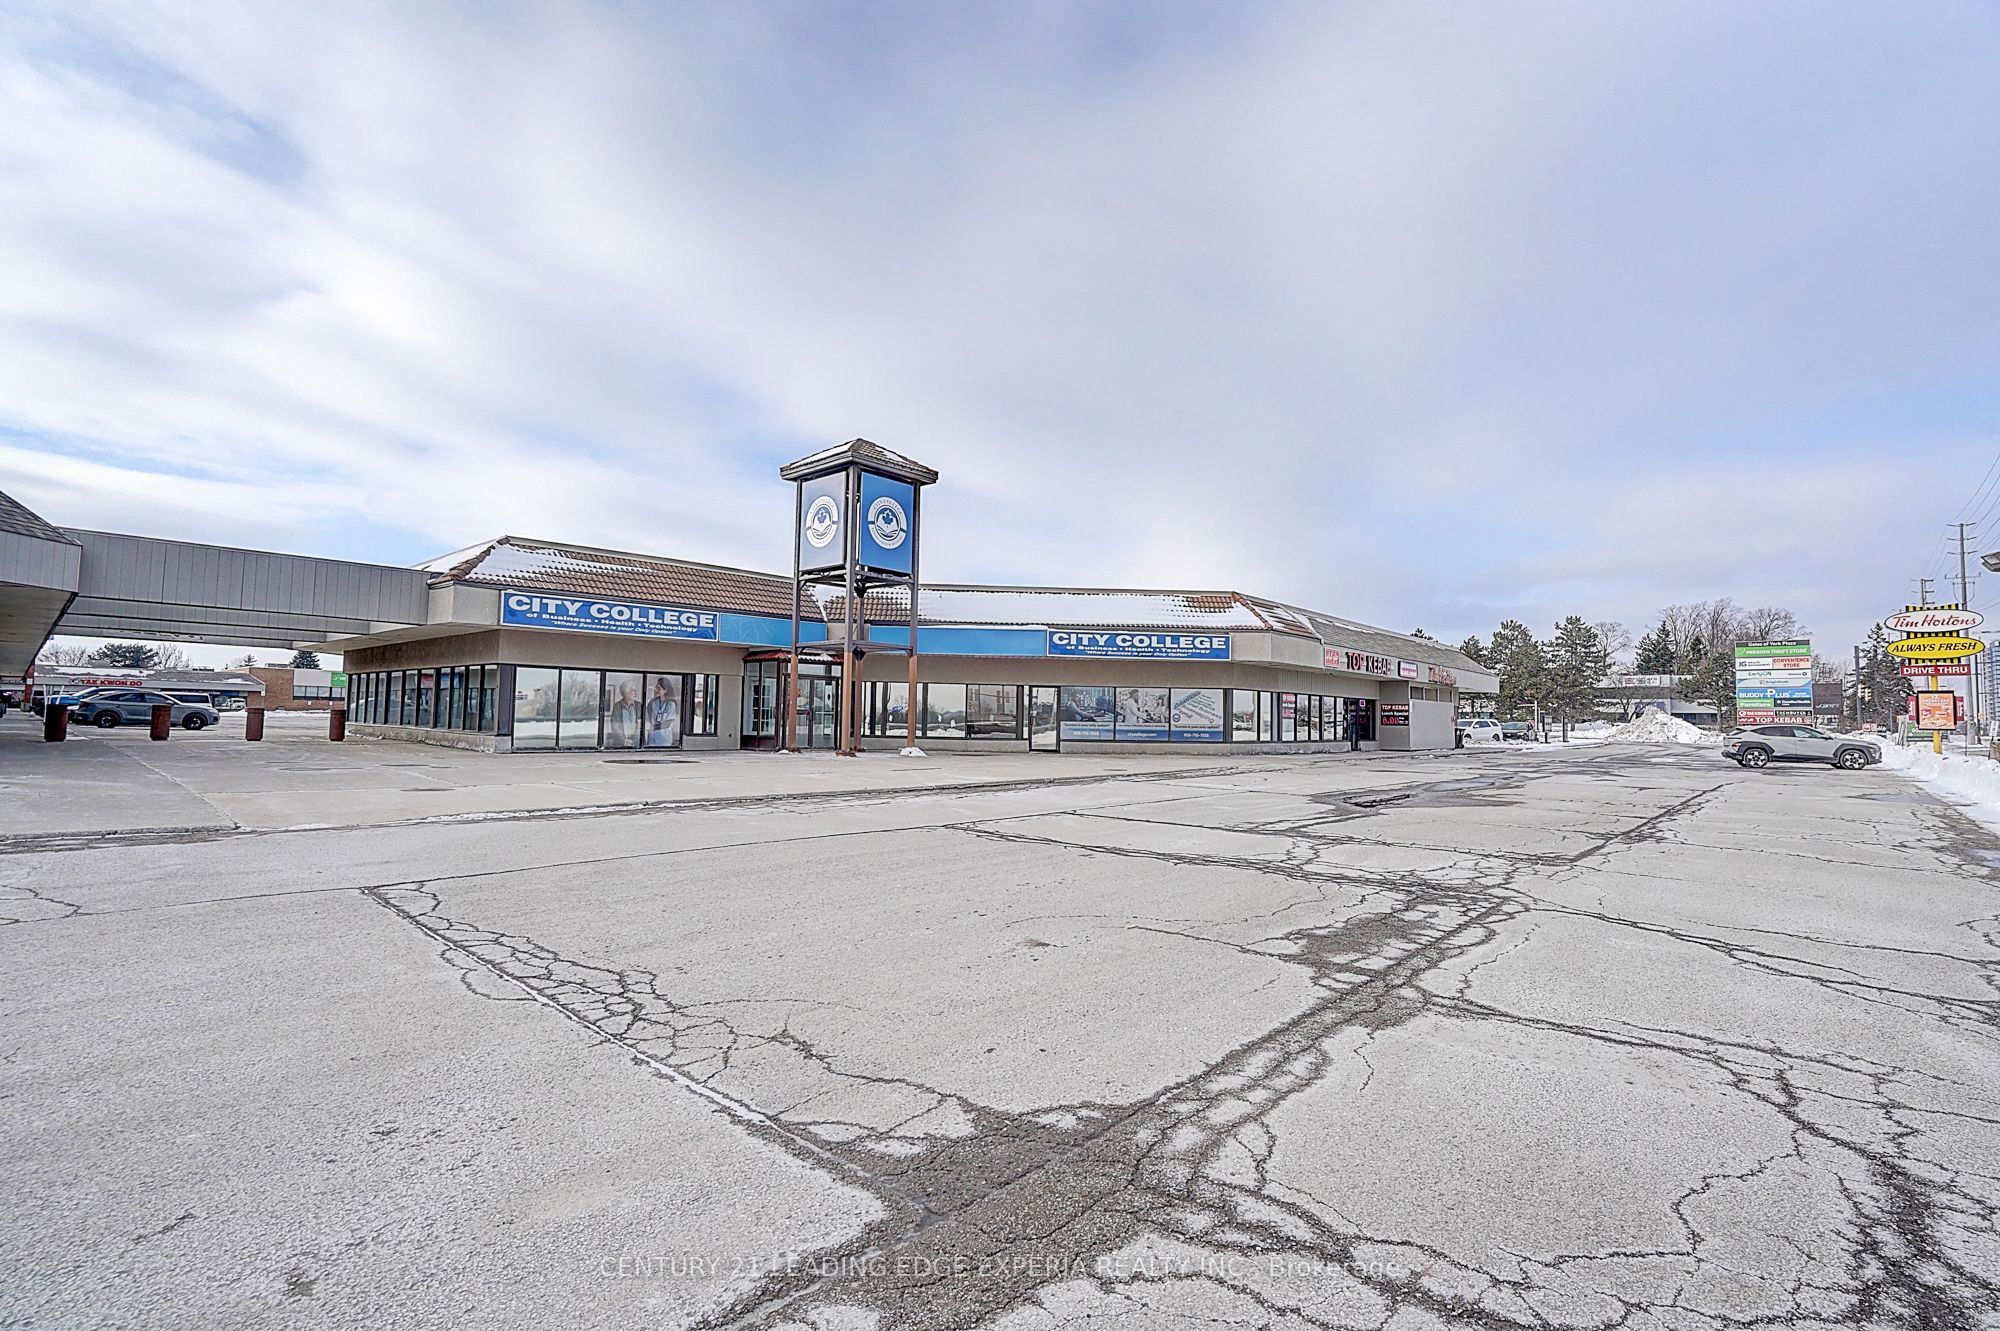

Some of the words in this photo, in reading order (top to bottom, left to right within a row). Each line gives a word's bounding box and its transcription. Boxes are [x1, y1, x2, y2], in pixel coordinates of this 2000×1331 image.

[508, 595, 584, 615] CITY
[589, 603, 714, 628] COLLEGE
[541, 614, 592, 623] Business
[601, 619, 635, 627] Health
[643, 623, 699, 632] Technology
[1893, 615, 1919, 628] Tim
[1921, 614, 1976, 627] Hortons
[1053, 632, 1110, 646] CITY
[1116, 634, 1226, 649] COLLEGE
[1892, 643, 1936, 653] ALWAYS
[1938, 642, 1978, 652] FRESH
[1346, 652, 1366, 671] TOP
[1366, 655, 1392, 675] KEBAB
[1903, 666, 1936, 675] DRIVE
[1938, 666, 1968, 674] THRU
